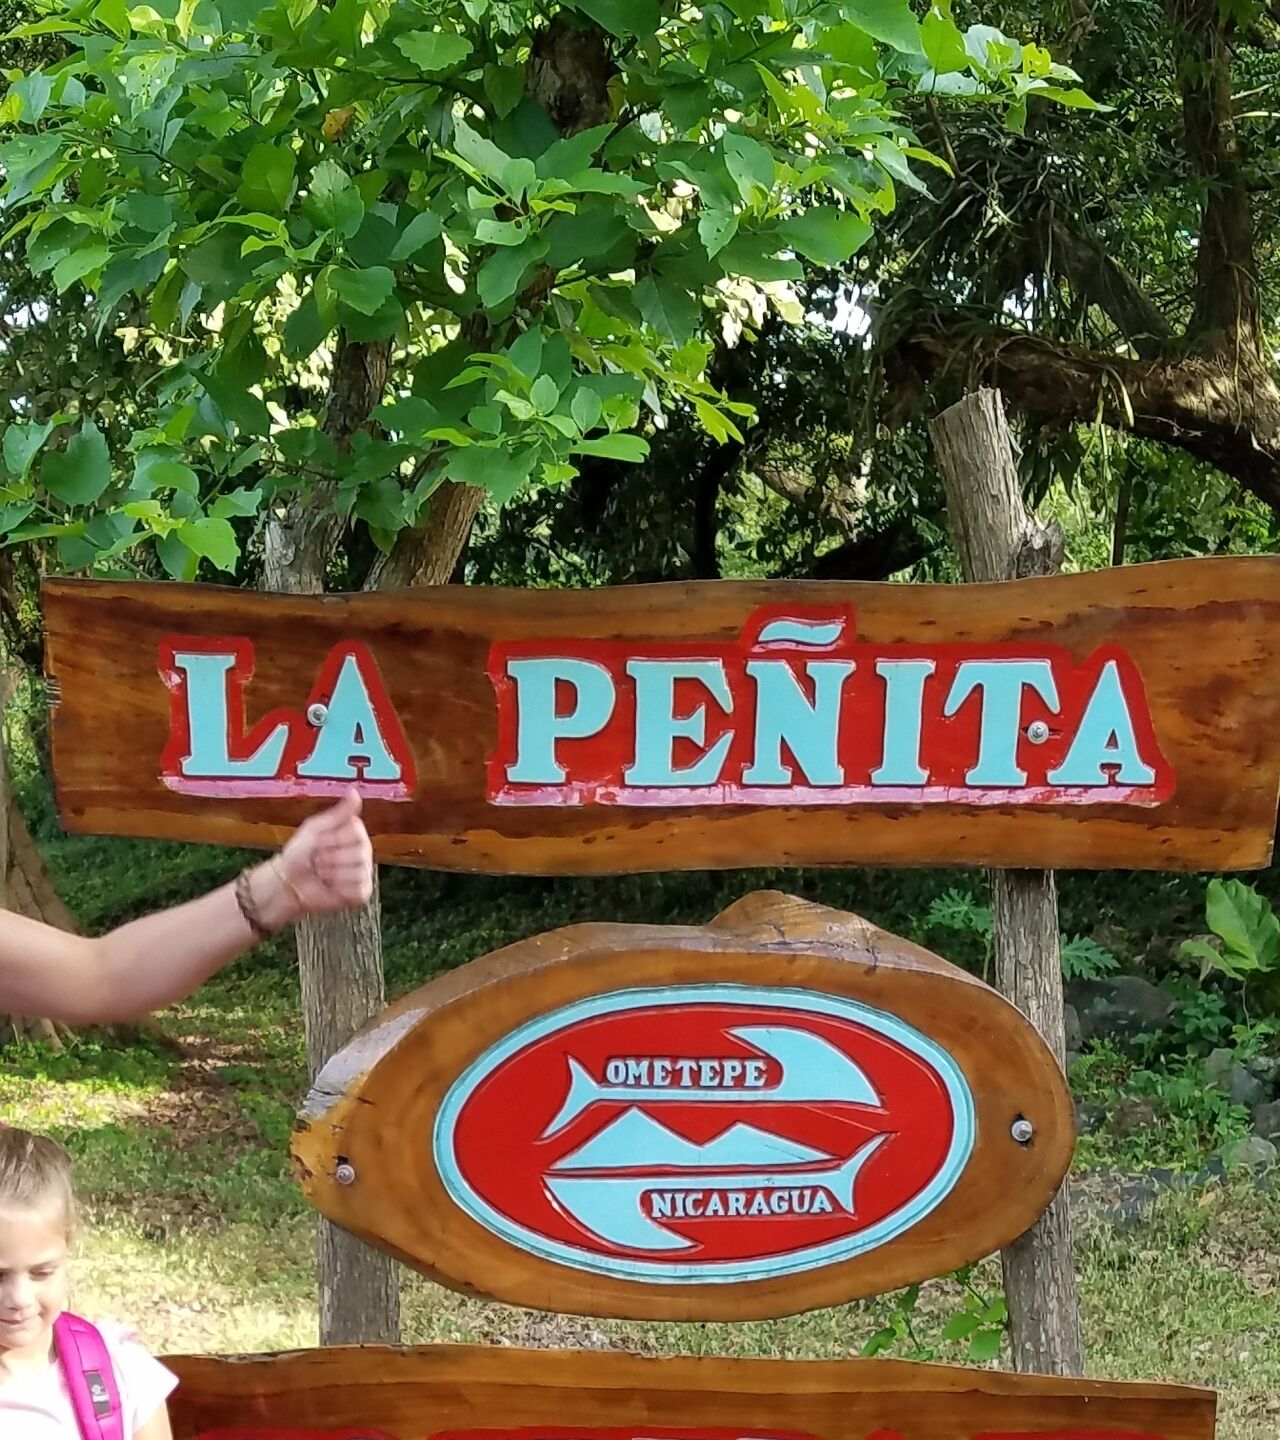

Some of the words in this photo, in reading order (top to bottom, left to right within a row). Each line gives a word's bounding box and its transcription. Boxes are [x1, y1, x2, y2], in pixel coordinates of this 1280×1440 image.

[174, 652, 401, 780] LA
[503, 618, 1157, 788] PEÑITA
[606, 1057, 768, 1088] OMETEPE
[651, 1189, 832, 1217] NICARAGUA
